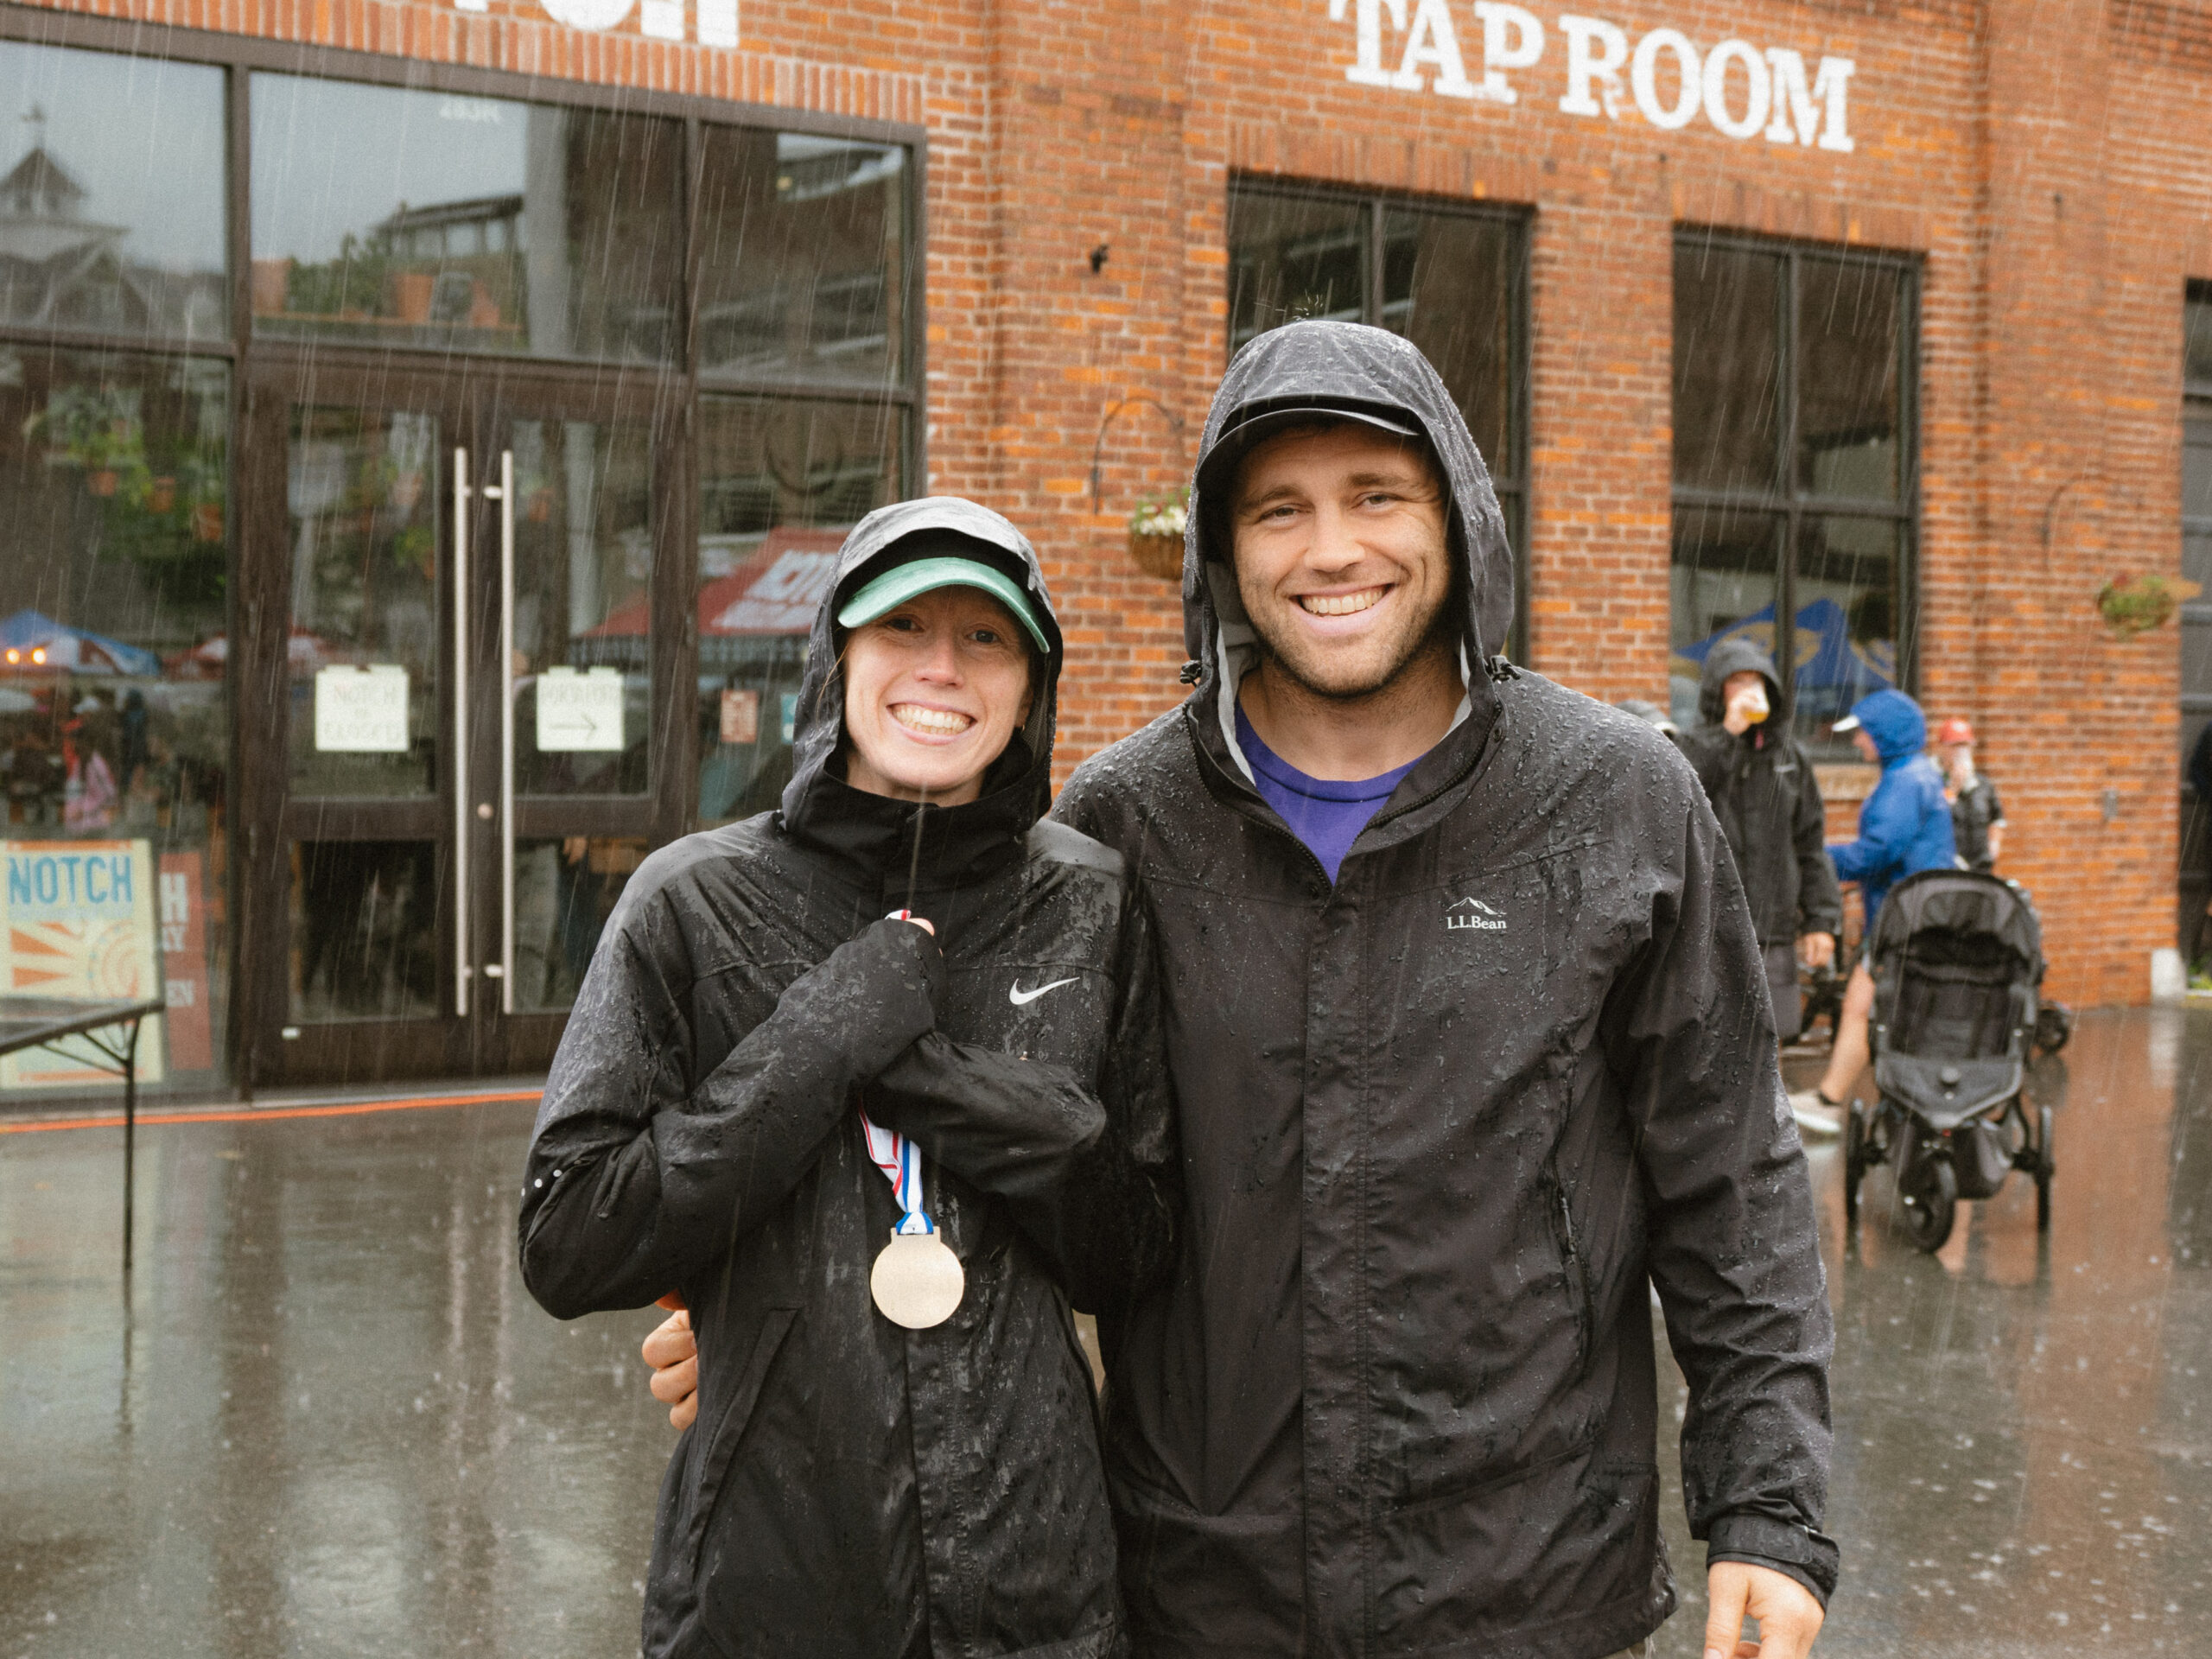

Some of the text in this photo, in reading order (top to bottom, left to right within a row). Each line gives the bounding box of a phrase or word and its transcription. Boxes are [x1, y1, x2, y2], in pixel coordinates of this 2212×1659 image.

[1328, 0, 1857, 153] TAP ROOM
[8, 855, 132, 905] NOTCH
